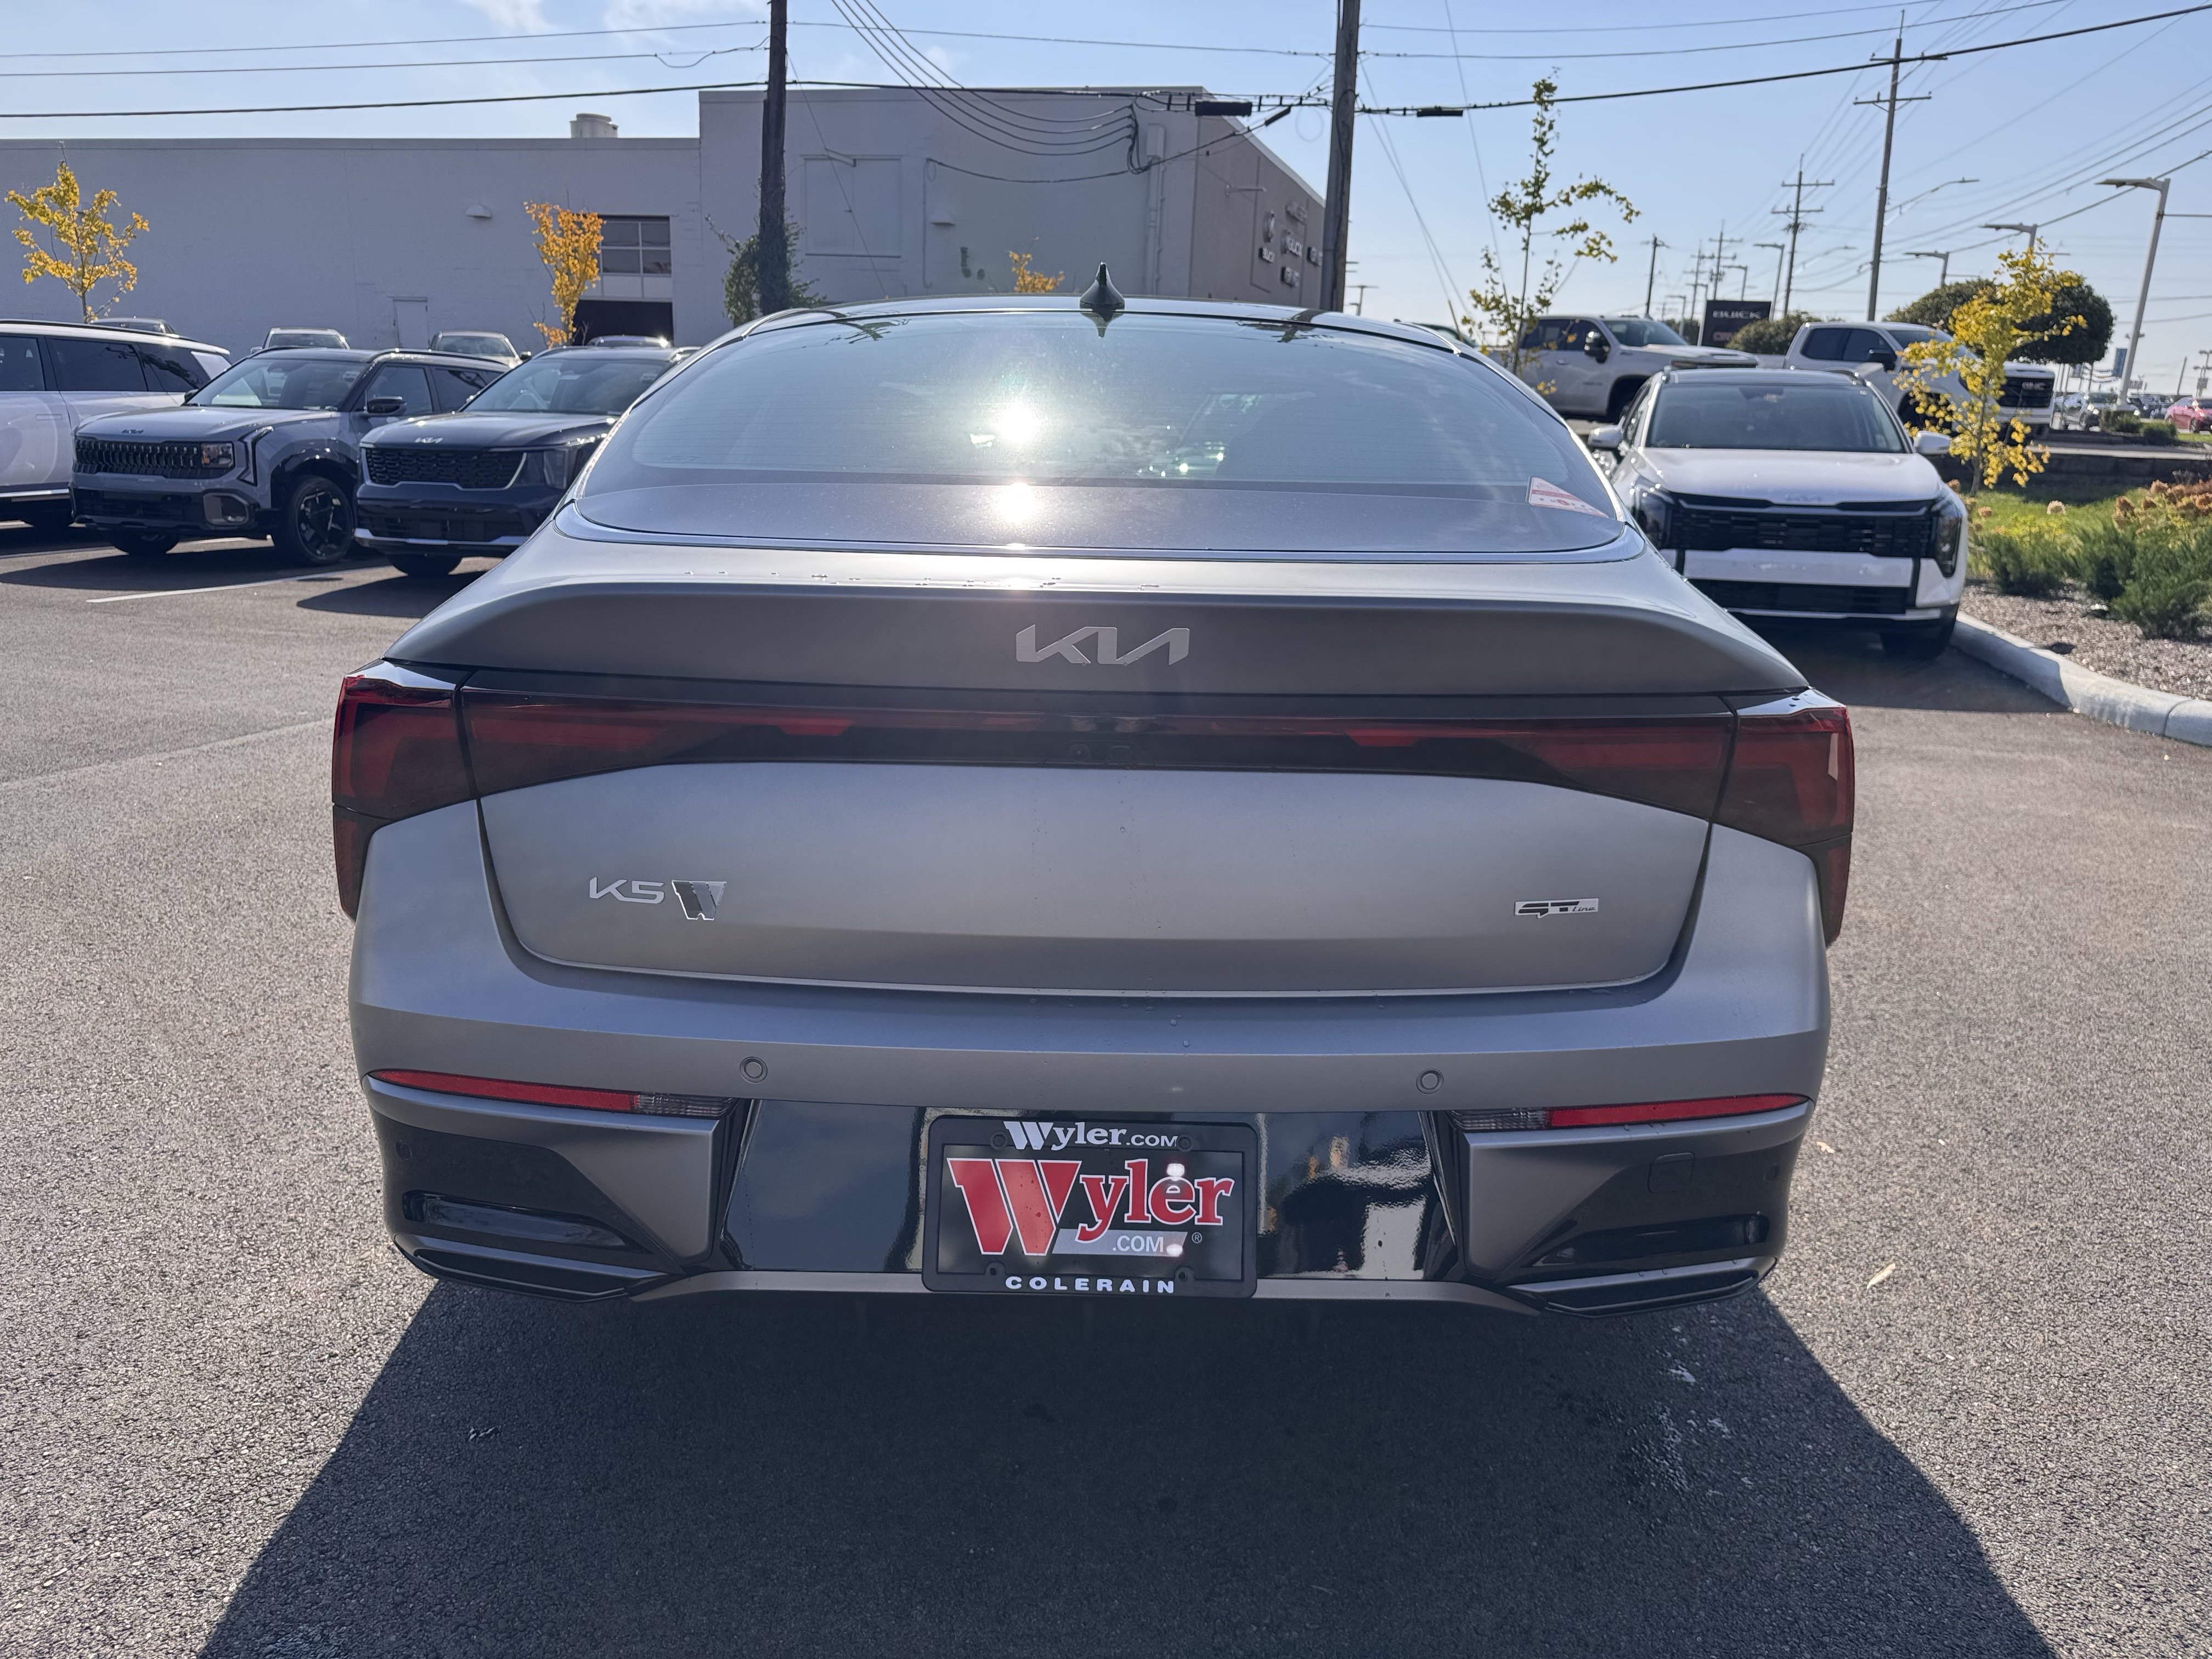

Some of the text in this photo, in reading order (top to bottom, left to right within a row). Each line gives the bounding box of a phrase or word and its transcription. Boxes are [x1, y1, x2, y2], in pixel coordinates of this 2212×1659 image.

[1712, 310, 1761, 319] BUICK
[1016, 613, 1190, 666] KIA
[589, 877, 665, 904] K5
[1518, 901, 1580, 917] GT
[946, 1158, 1235, 1256] Wyler
[1113, 1235, 1164, 1253] .COM
[1005, 1276, 1175, 1294] COLERAIN
